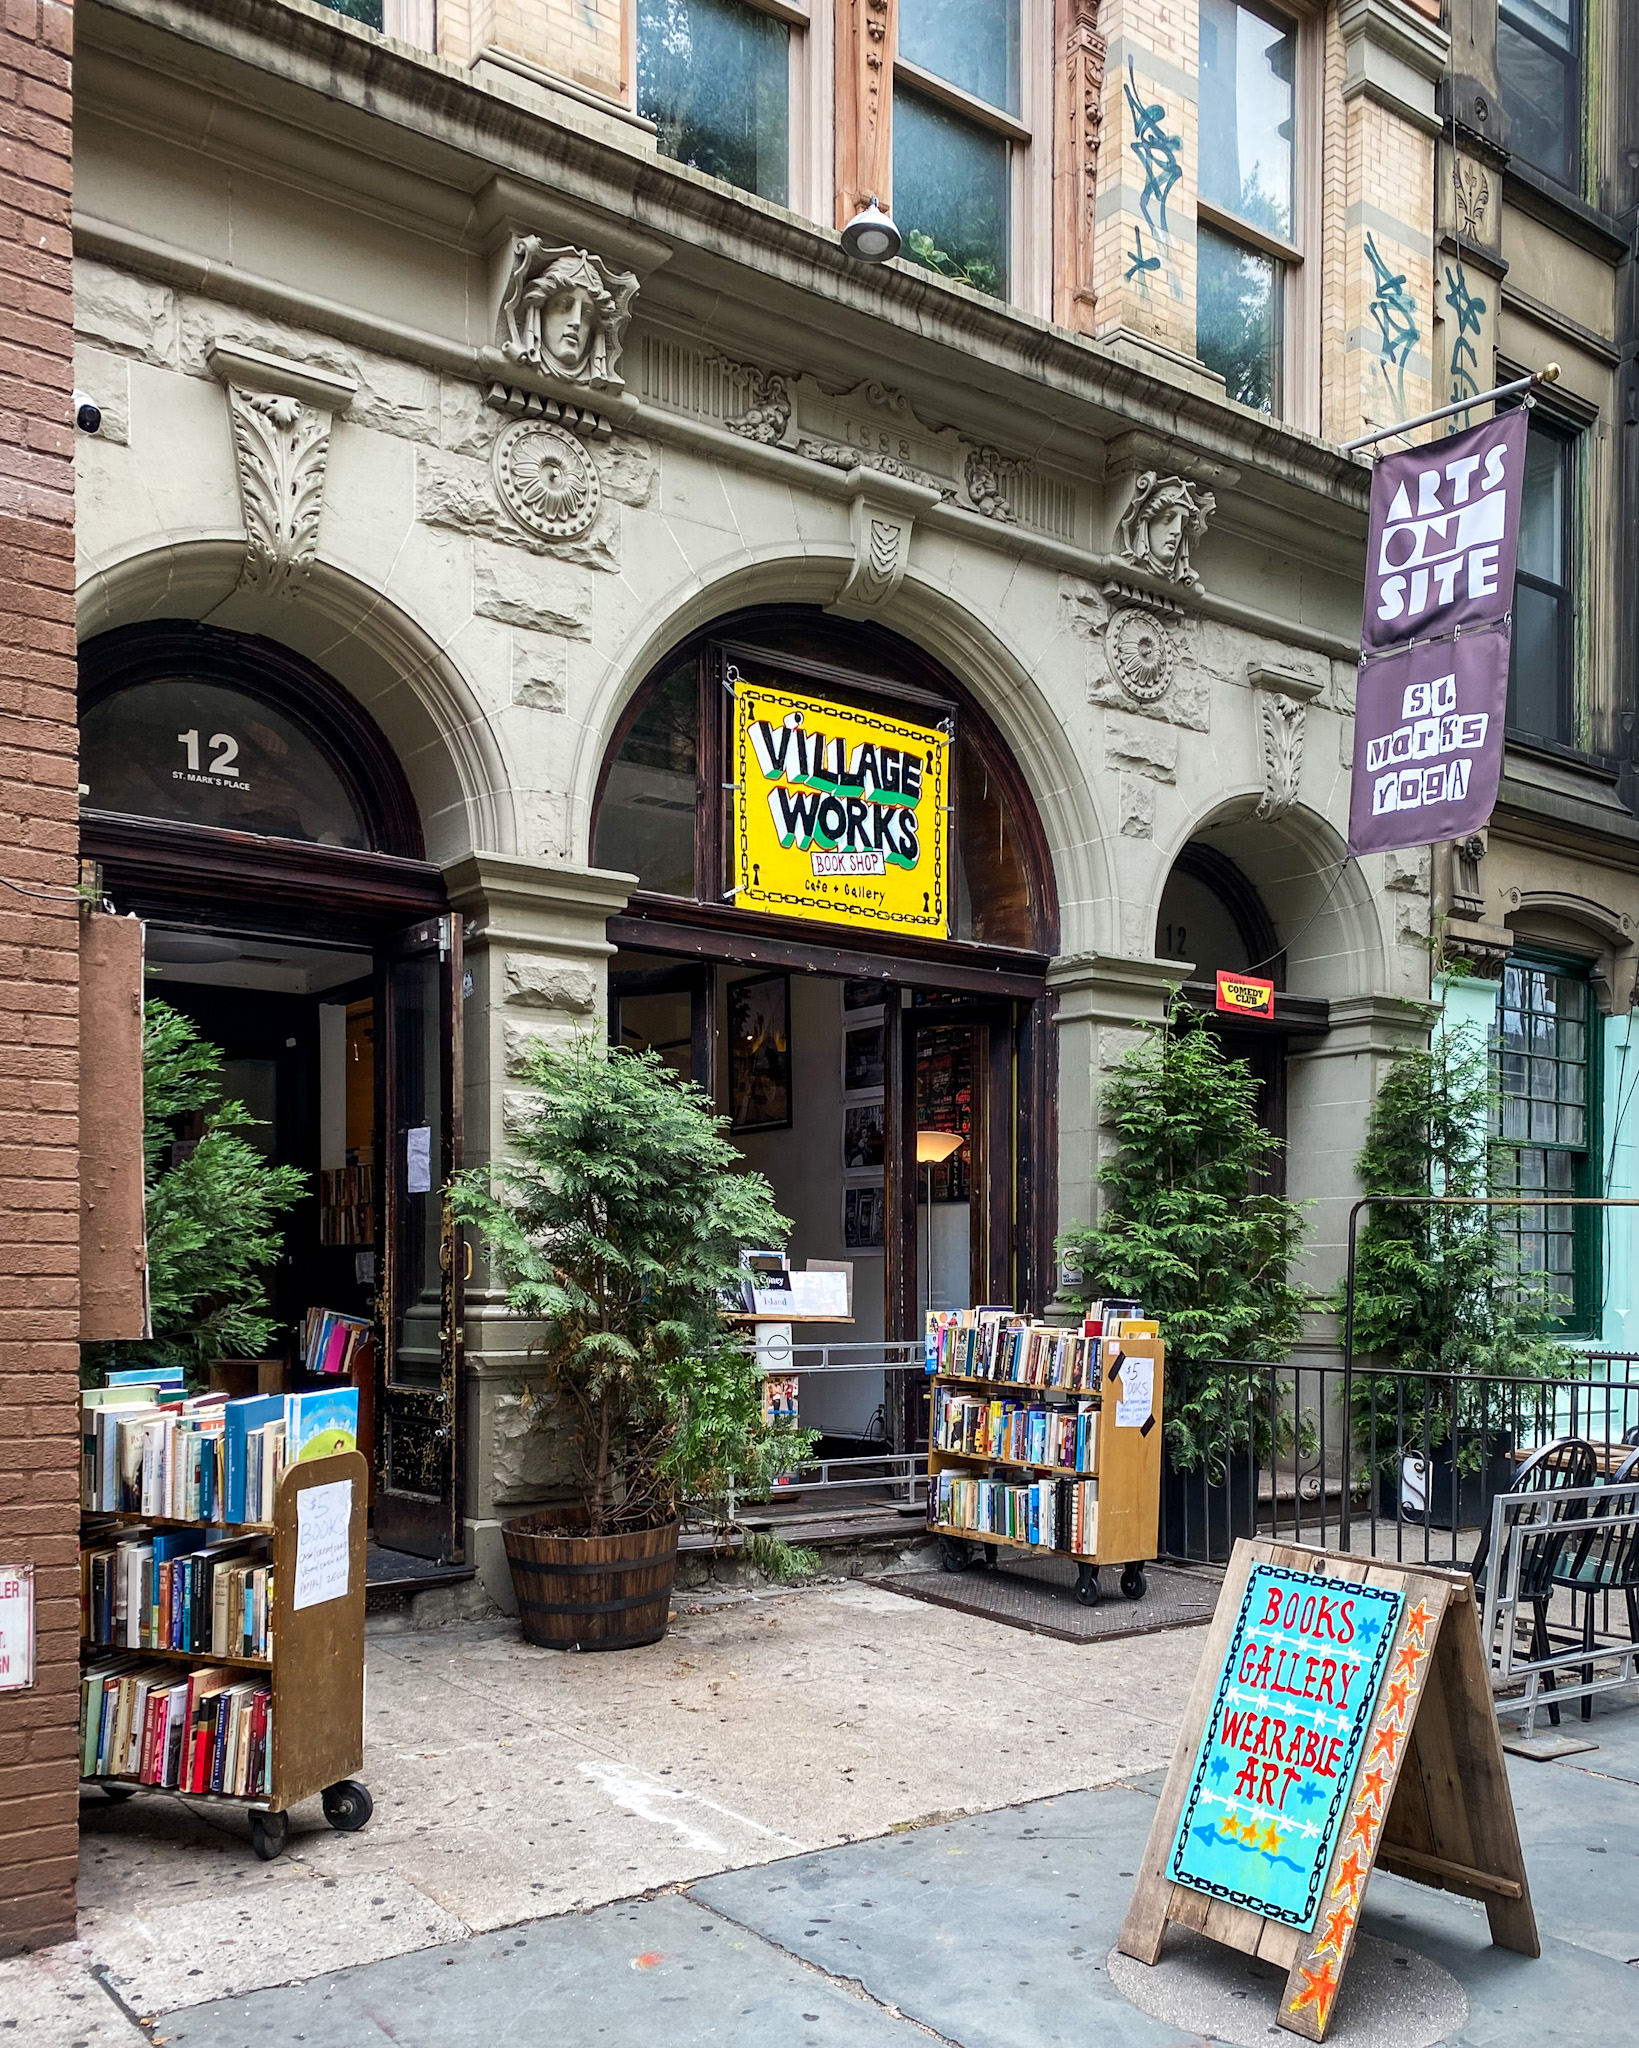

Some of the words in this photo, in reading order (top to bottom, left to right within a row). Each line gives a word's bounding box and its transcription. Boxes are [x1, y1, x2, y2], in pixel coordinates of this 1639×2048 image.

[1386, 443, 1509, 523] ARTS
[1385, 515, 1460, 568] ON
[1377, 544, 1499, 621] SITE
[178, 729, 240, 777] 12
[172, 770, 186, 781] ST.
[187, 773, 222, 786] MARK'S
[223, 779, 251, 792] PLACE
[767, 786, 920, 870] WORKS
[816, 855, 846, 873] BOOK
[850, 854, 879, 873] SHOP
[804, 878, 828, 893] Cafe
[844, 880, 886, 906] Gallery
[1227, 985, 1264, 998] COMEDY
[1235, 994, 1257, 1005] CLUB
[759, 1274, 785, 1287] Coney
[763, 1297, 787, 1306] Island
[1126, 1362, 1140, 1381] $5
[300, 1513, 347, 1546] BOOKS
[1260, 1587, 1355, 1644] BOOKS
[1238, 1642, 1360, 1710] GALLERY
[1220, 1707, 1344, 1779] WEARABLE
[1233, 1755, 1302, 1811] ART
